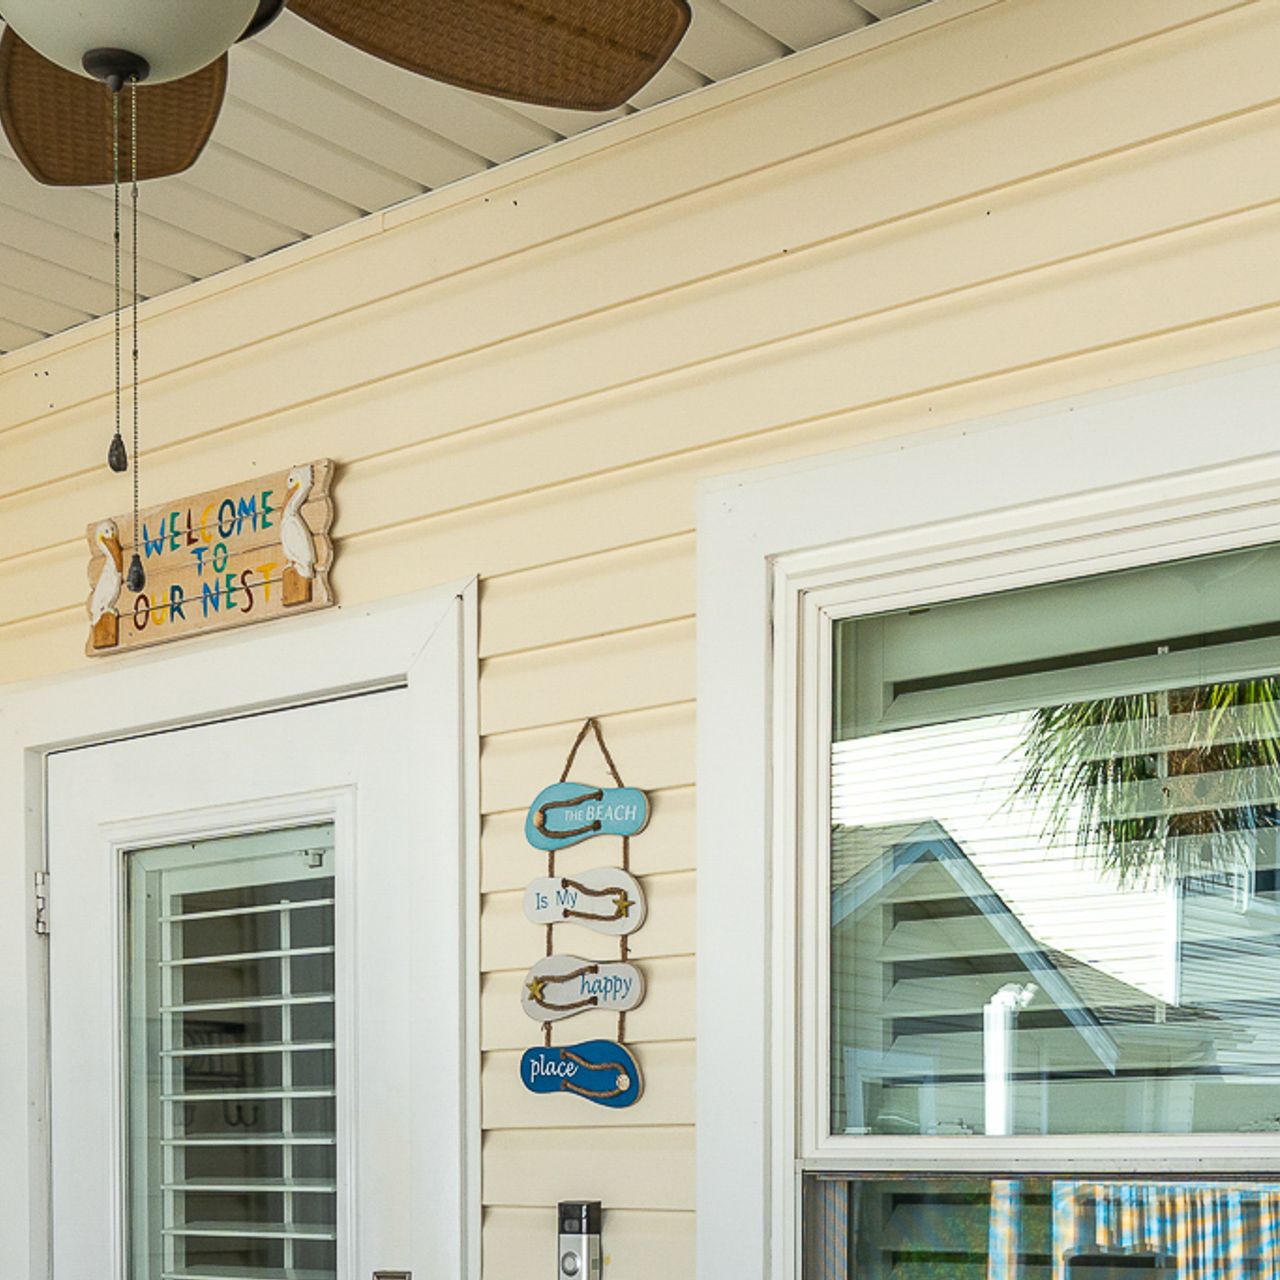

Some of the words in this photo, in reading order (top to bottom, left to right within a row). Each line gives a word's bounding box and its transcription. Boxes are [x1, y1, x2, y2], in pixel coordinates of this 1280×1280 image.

[142, 490, 274, 559] WELCOME
[190, 542, 228, 576] TO
[133, 584, 186, 631] OUR
[201, 562, 278, 618] NEST
[564, 809, 584, 822] THE
[585, 803, 638, 822] BEACH
[535, 892, 549, 911] Is
[555, 889, 579, 909] My
[579, 973, 633, 1001] happy
[529, 1053, 580, 1083] place
